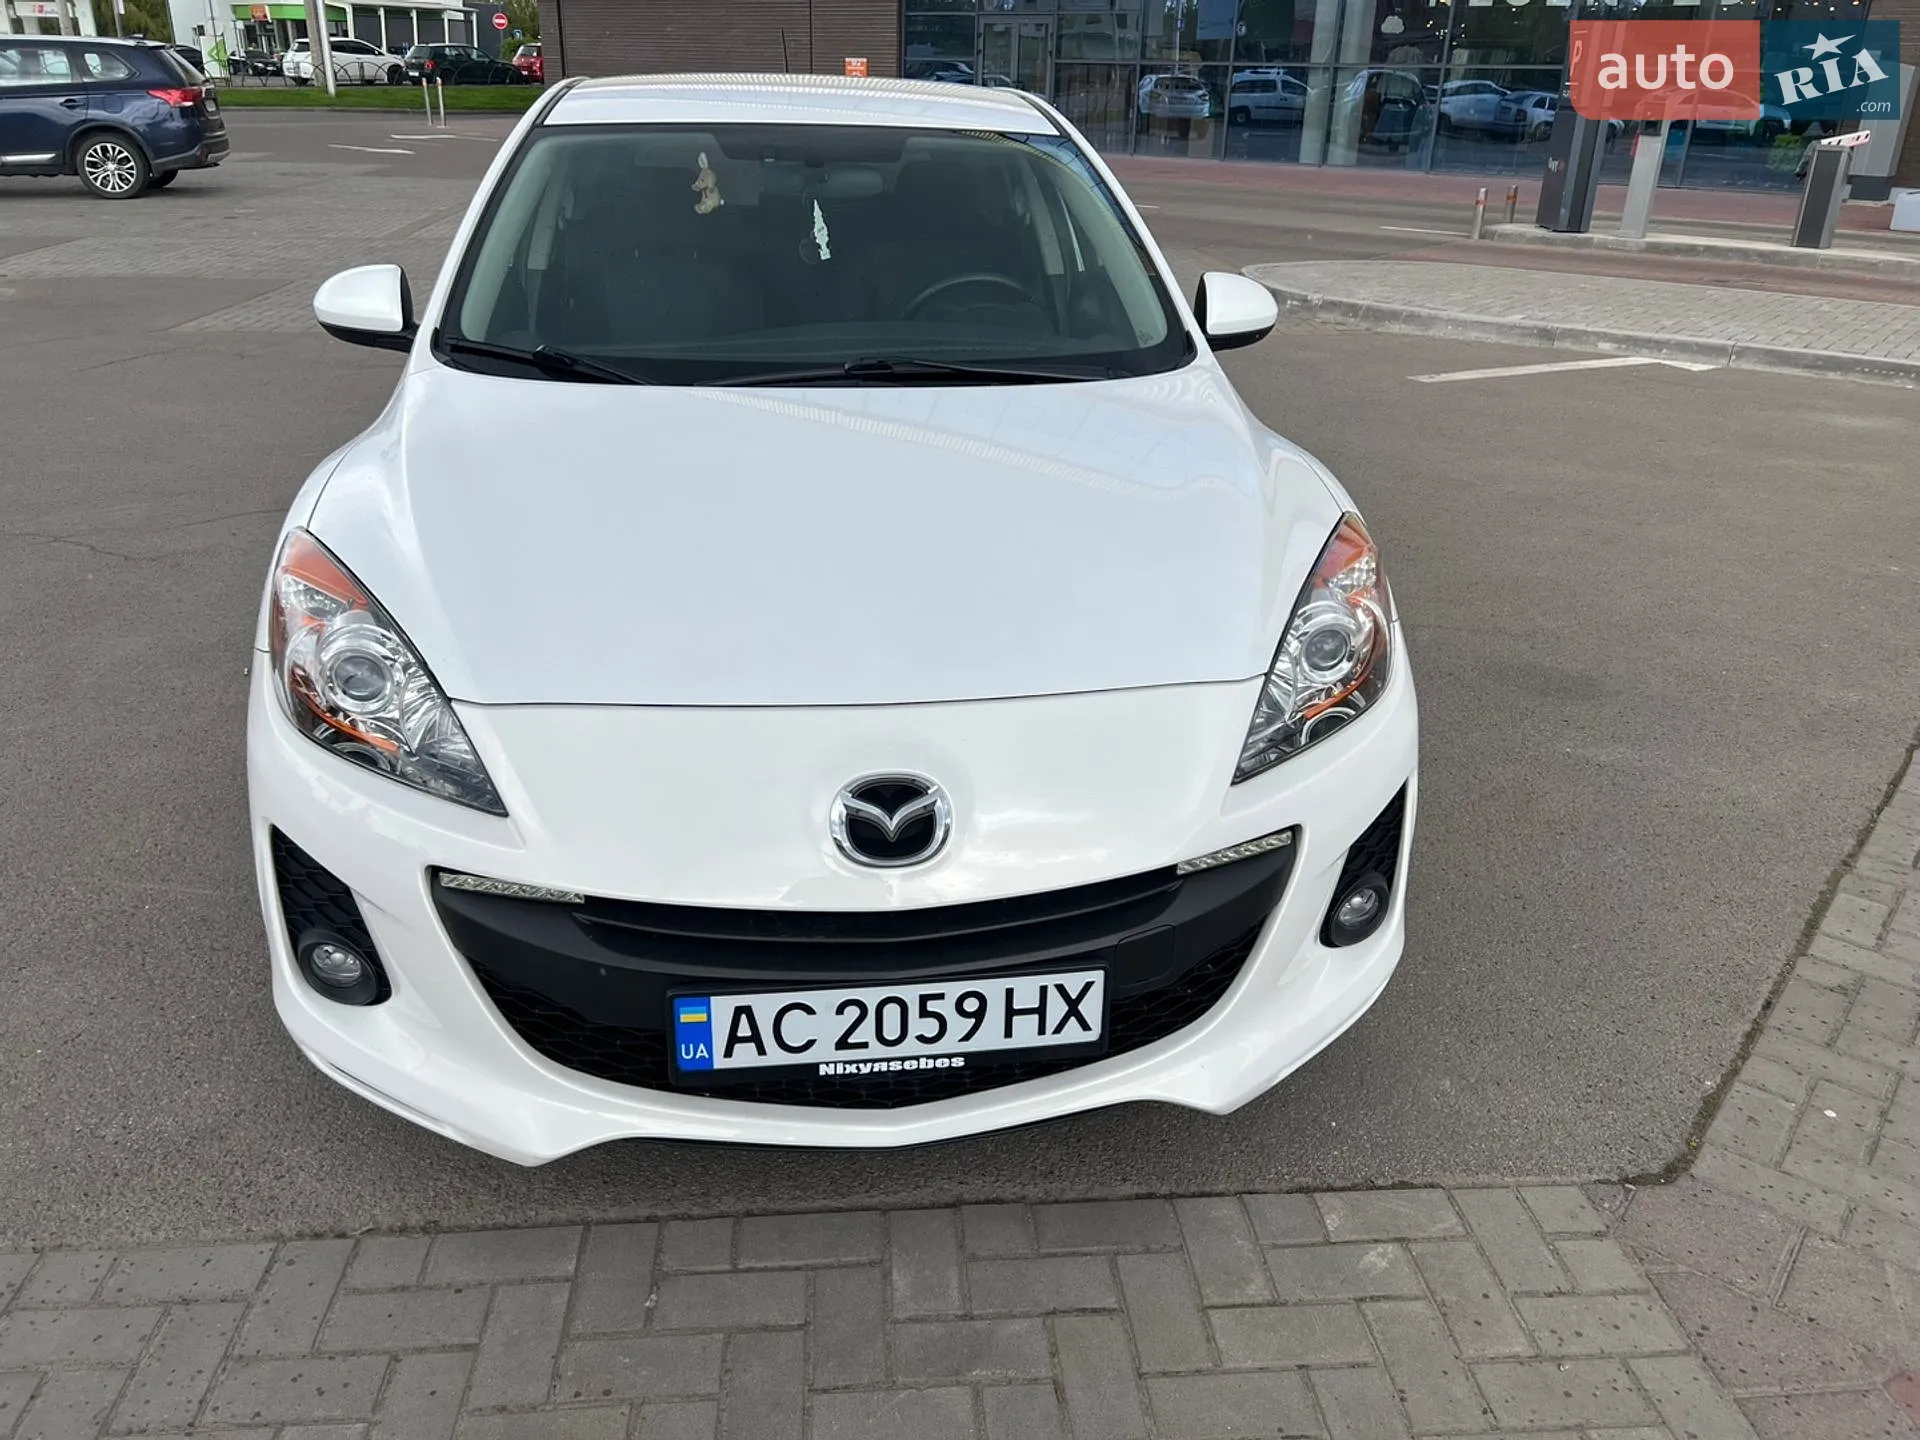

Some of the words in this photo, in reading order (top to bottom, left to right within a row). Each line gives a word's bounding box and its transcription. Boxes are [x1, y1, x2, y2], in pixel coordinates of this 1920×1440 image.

[723, 1002, 818, 1058] AC
[835, 990, 989, 1051] 2059
[1004, 981, 1096, 1039] HX
[682, 1045, 709, 1059] UA
